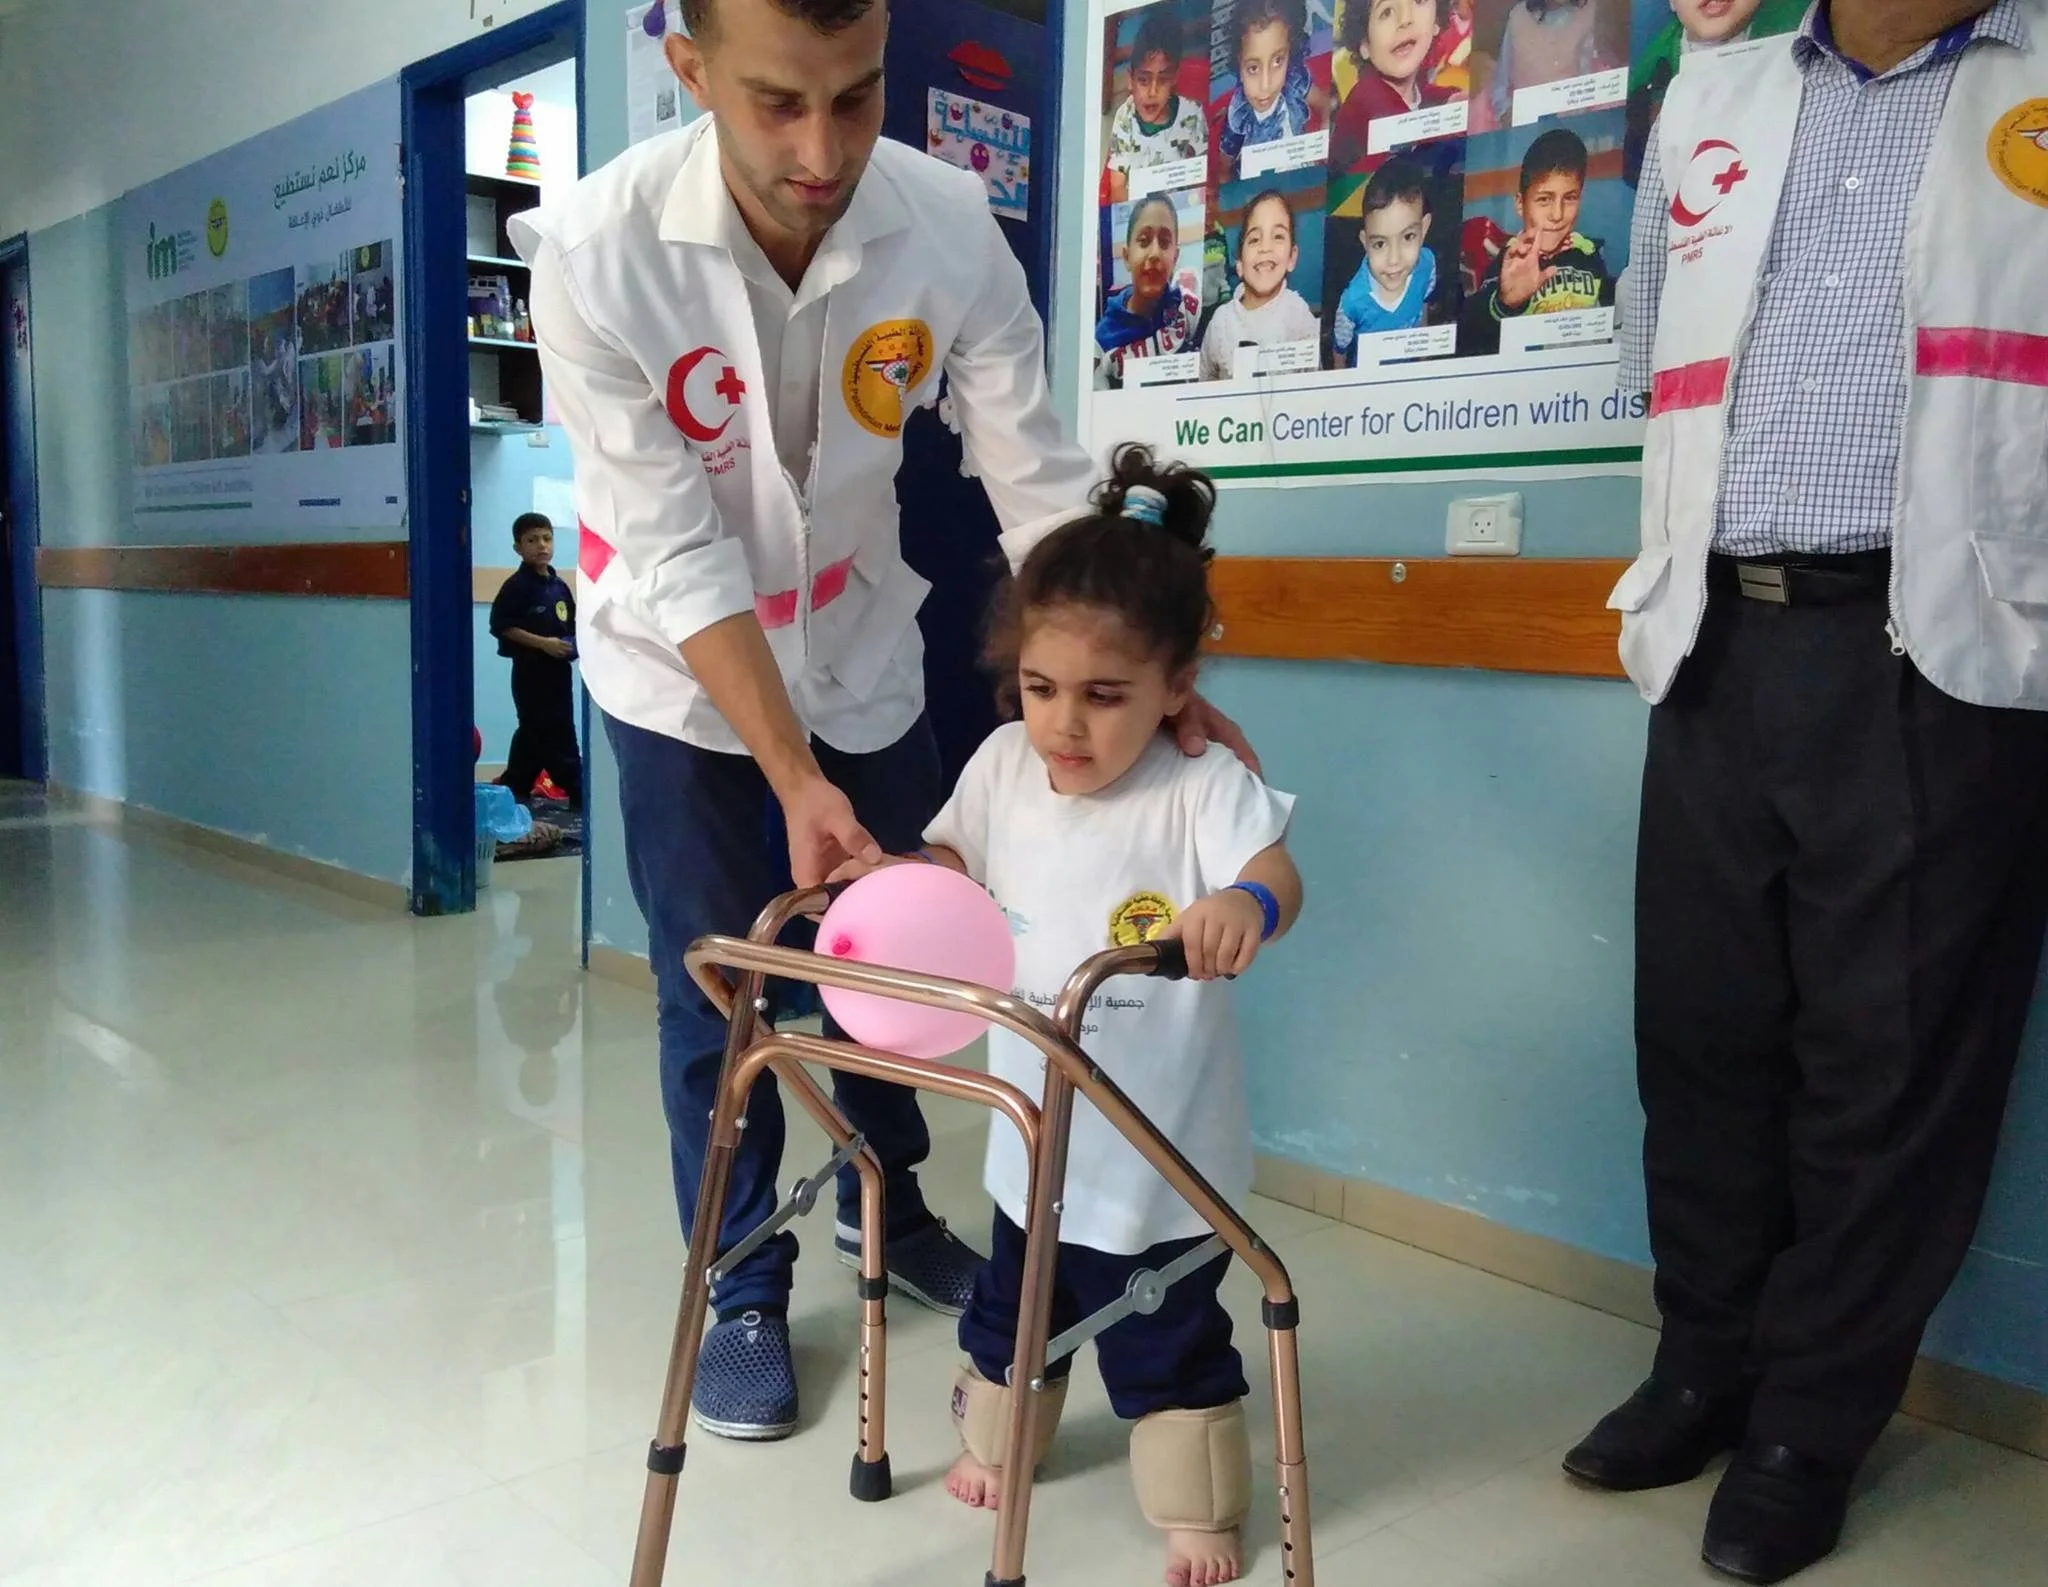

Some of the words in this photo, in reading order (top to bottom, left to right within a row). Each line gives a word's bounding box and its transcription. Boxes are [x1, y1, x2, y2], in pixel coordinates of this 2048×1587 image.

[1532, 267, 1595, 303] NITED
[1176, 418, 1210, 446] We
[1218, 416, 1264, 444] Can
[1272, 411, 1354, 441] Center
[1361, 406, 1395, 436] for
[1403, 399, 1519, 433] Children
[1529, 391, 1589, 425] with
[1028, 990, 1057, 1006] لطبية
[1105, 994, 1145, 1011] جمعية
